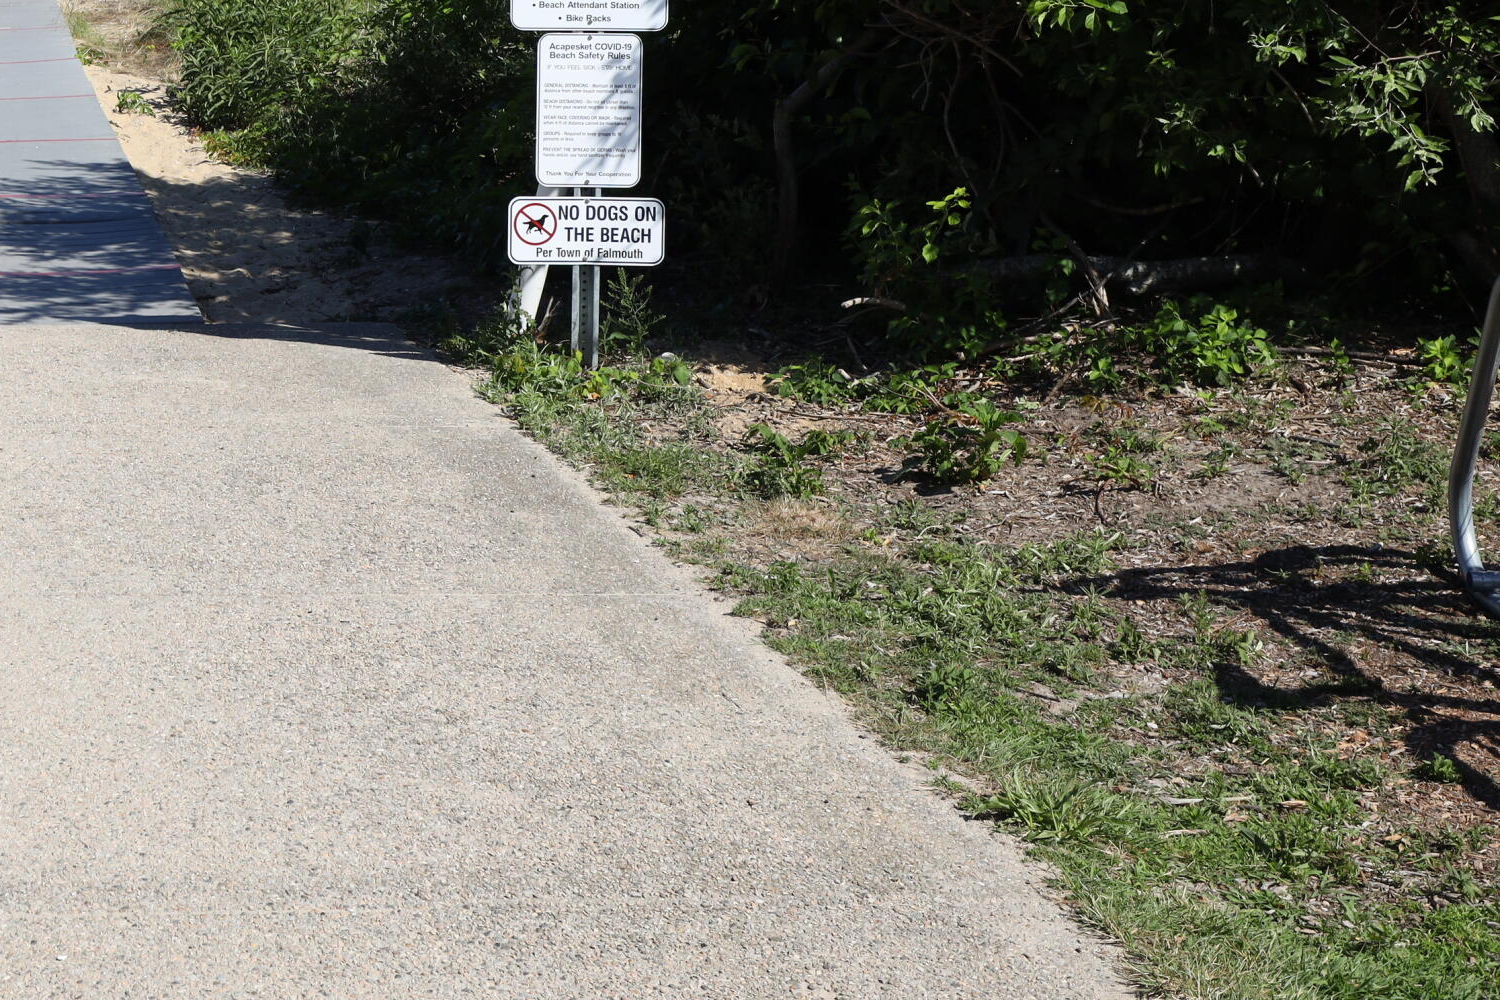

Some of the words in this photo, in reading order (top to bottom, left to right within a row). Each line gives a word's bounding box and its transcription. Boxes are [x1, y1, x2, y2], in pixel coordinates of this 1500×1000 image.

[549, 43, 592, 51] Acapesket
[578, 52, 604, 60] Safety
[558, 205, 579, 220] NO
[586, 205, 628, 221] DOGS
[635, 206, 656, 221] ON
[564, 227, 594, 242] THE
[601, 228, 651, 243] BEACH
[536, 247, 552, 257] Per
[556, 248, 580, 257] Town
[584, 248, 593, 258] of
[598, 248, 643, 259] Falmouth
